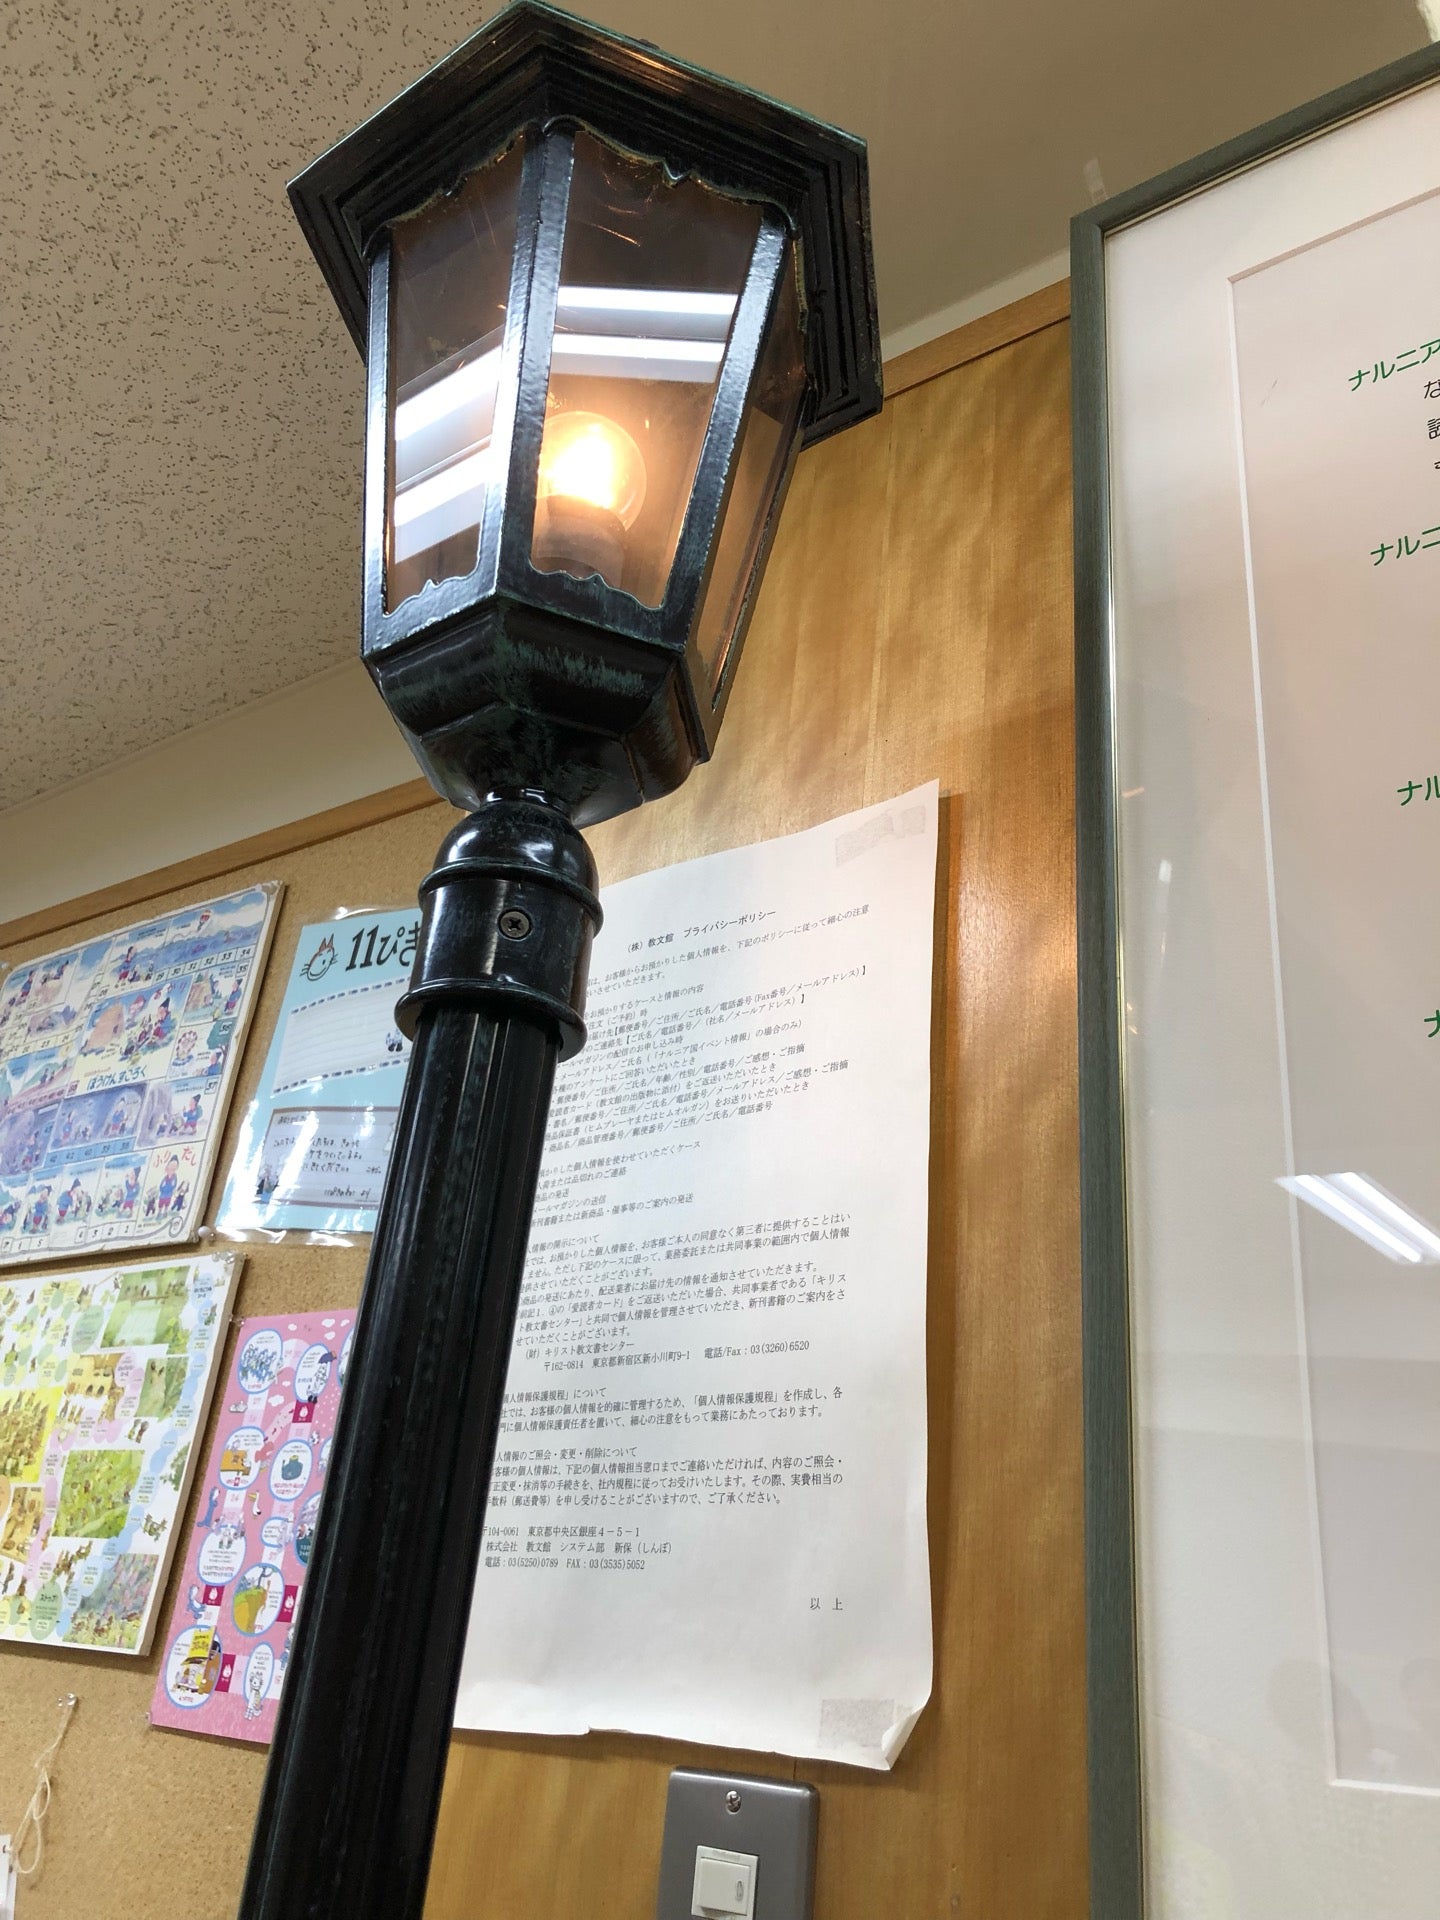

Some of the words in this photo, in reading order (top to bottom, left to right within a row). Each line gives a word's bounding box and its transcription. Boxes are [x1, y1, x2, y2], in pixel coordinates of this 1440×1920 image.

[1348, 339, 1440, 391] ナルニア
[1370, 526, 1440, 567] ナルニ
[683, 907, 776, 939] プライバシーポリシー
[544, 1359, 583, 1372] 〒162-0814
[490, 1454, 842, 1477] 客様の個人情報は、下記の個人情報担当窓口までご連絡いただければ、内容のご照会・
[488, 1471, 842, 1491] 正変更・抹消等の手続きを、社内規程に従ってお受けいたします。その際、実費相当の
[486, 1541, 516, 1552] 株式会社
[526, 1541, 550, 1553] 教文館
[560, 1542, 604, 1553] システム部
